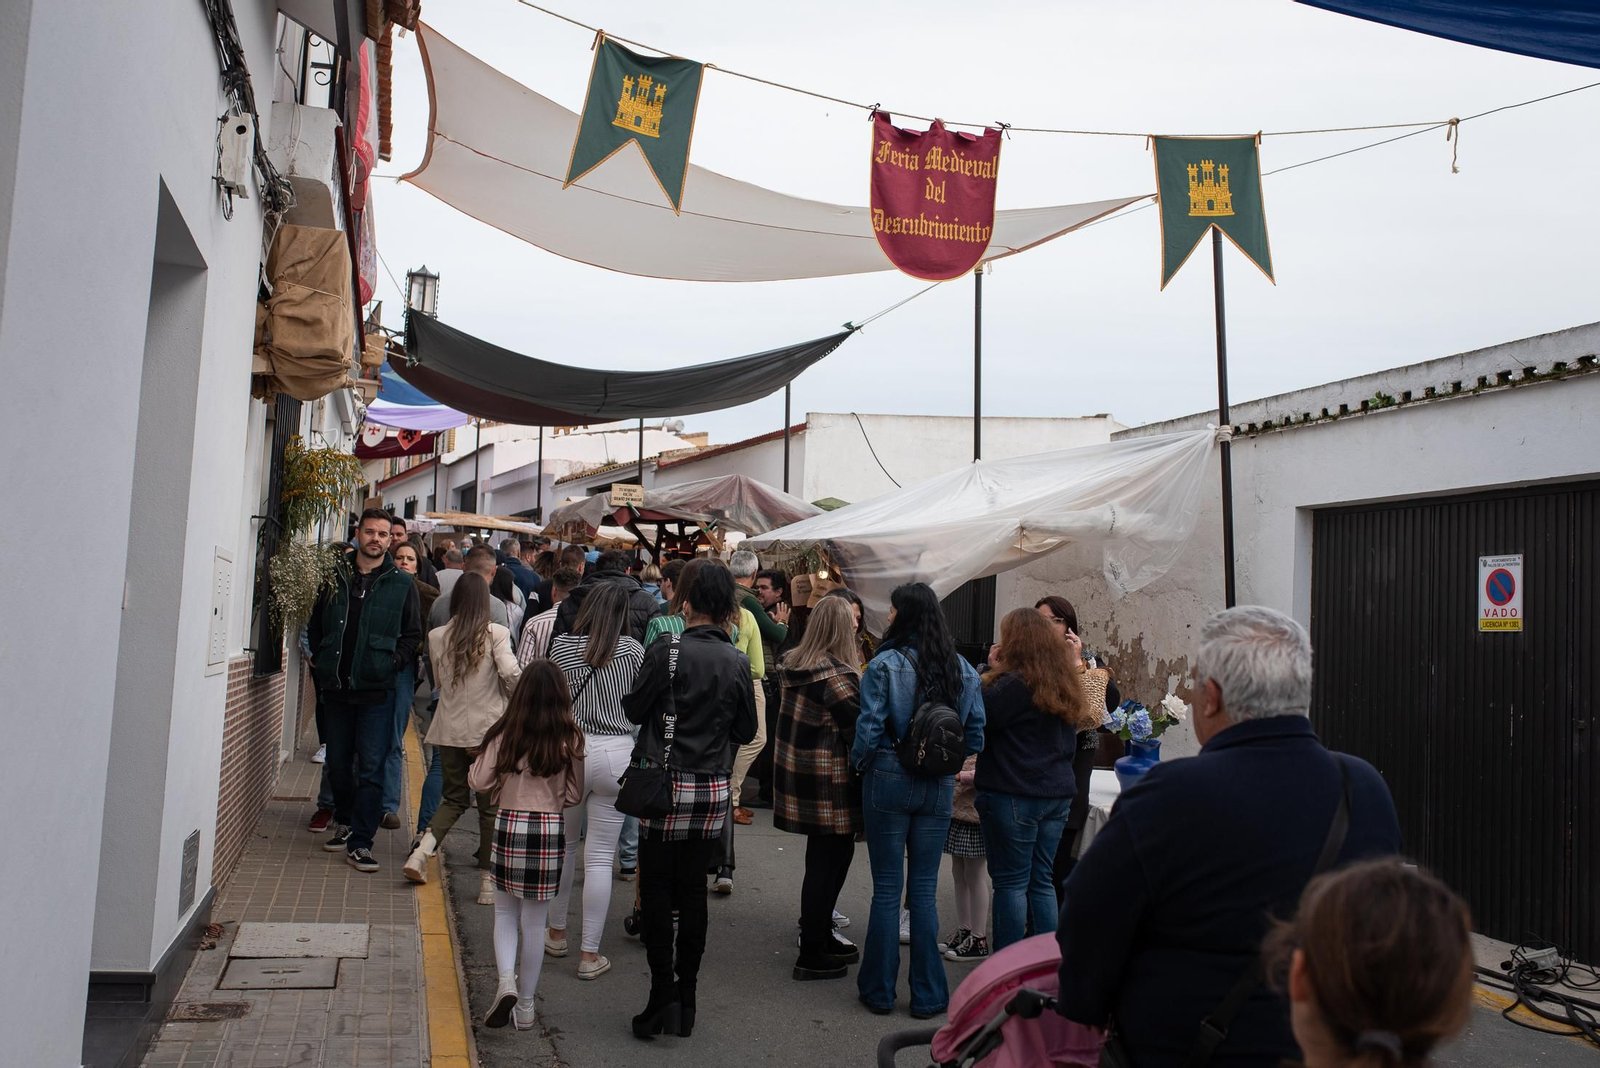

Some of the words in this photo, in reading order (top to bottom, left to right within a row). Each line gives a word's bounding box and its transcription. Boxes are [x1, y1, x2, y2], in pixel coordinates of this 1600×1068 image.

[875, 140, 919, 171] Feria
[924, 146, 998, 179] Medieval
[924, 177, 946, 204] del
[873, 208, 990, 243] Descubrimiento
[1484, 608, 1517, 617] VADO
[668, 648, 678, 679] BIMBA
